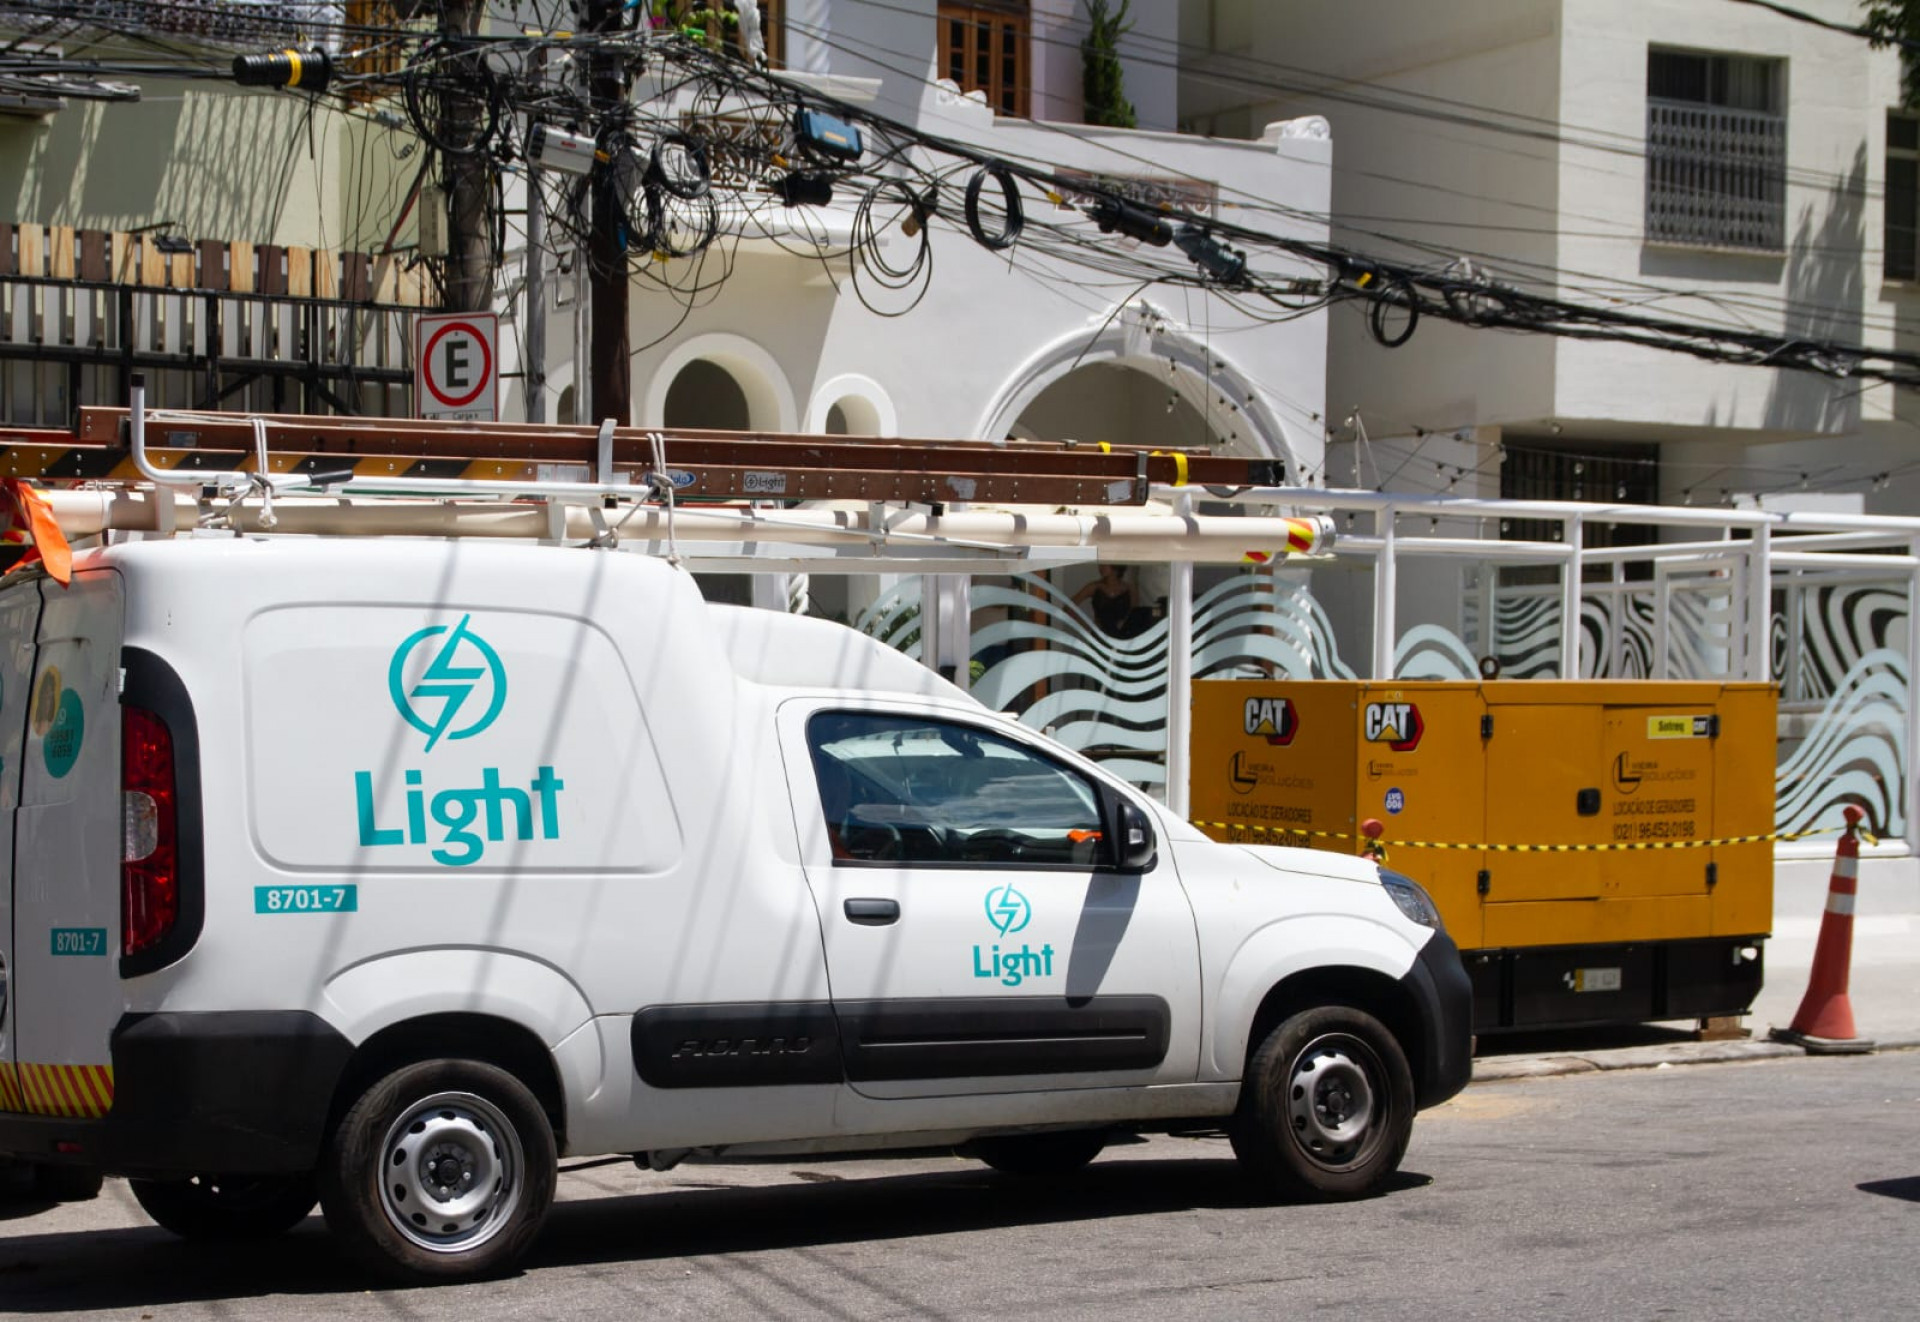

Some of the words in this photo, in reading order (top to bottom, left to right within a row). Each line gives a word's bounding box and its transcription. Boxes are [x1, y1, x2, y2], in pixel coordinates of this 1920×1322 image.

[446, 341, 469, 388] E
[1244, 698, 1286, 734] CAT
[1366, 704, 1411, 740] CAT
[355, 765, 564, 866] Light
[267, 889, 346, 910] 8701-7
[57, 932, 100, 951] 8701-7
[972, 944, 1055, 987] Light
